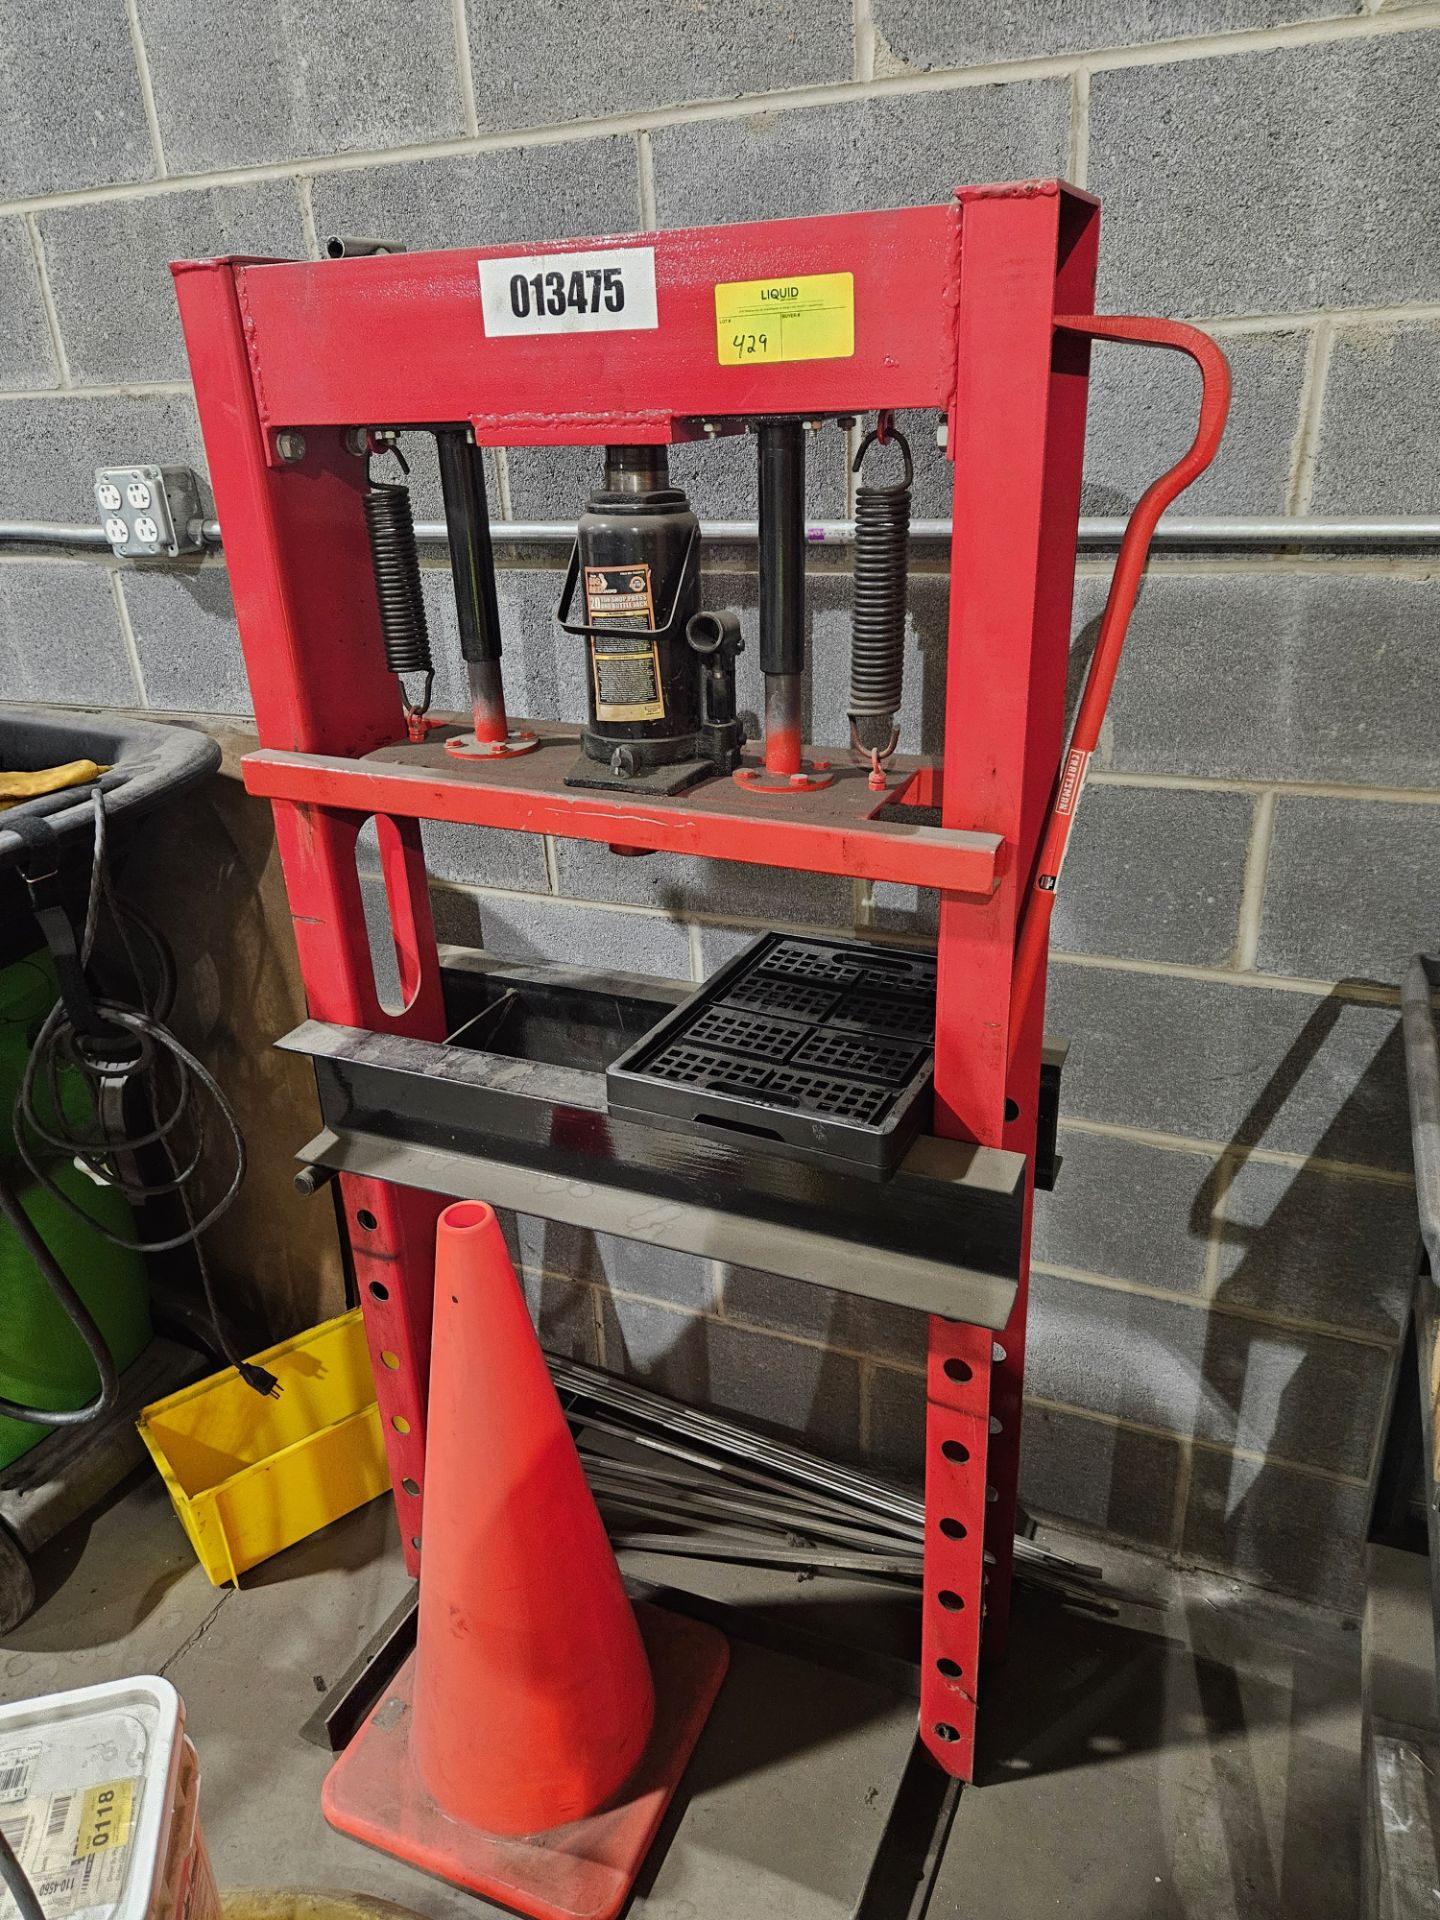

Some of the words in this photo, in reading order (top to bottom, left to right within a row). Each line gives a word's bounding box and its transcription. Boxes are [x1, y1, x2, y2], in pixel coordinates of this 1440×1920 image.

[509, 267, 624, 319] 013475
[761, 287, 799, 301] LIQUID
[732, 334, 768, 359] 429
[590, 596, 601, 609] 20
[628, 594, 647, 602] PRESS
[1058, 753, 1081, 809] CRAFTSMAN
[92, 1789, 115, 1847] 0118
[39, 1877, 76, 1897] 110-4560
